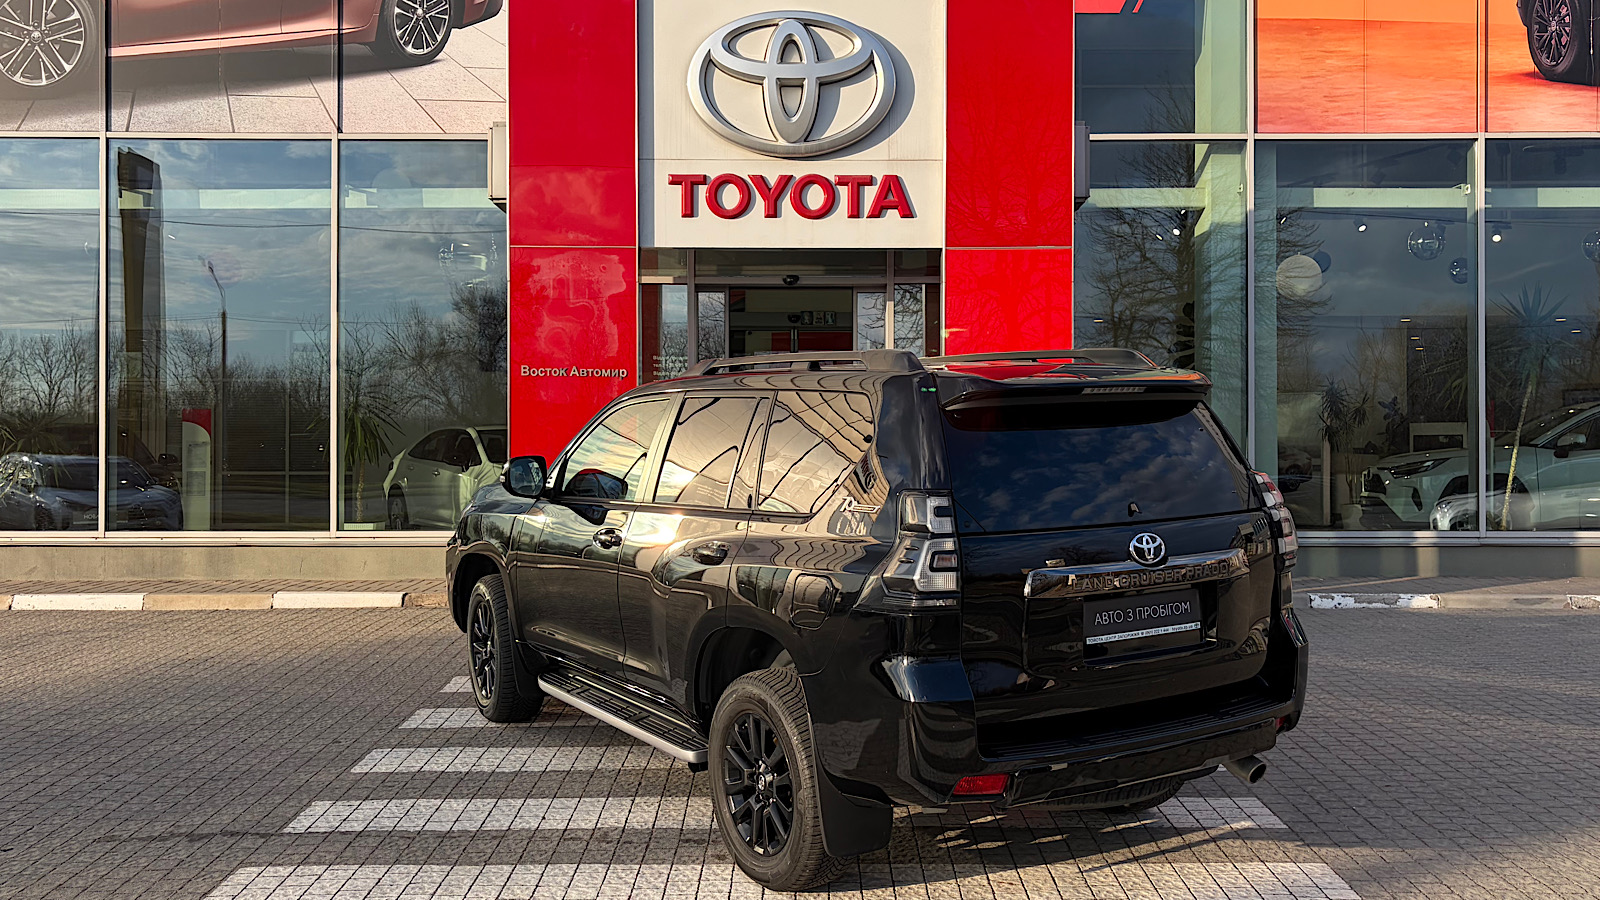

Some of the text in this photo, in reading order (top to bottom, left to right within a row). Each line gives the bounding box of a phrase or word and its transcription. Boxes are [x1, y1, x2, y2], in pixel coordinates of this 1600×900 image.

[667, 173, 915, 220] TOYOTA
[520, 365, 628, 380] Восток Автомир
[1072, 562, 1231, 591] LAND CRUISER PRADO
[1094, 609, 1124, 626] АВТО
[1135, 601, 1191, 621] ПРОБІГОМ
